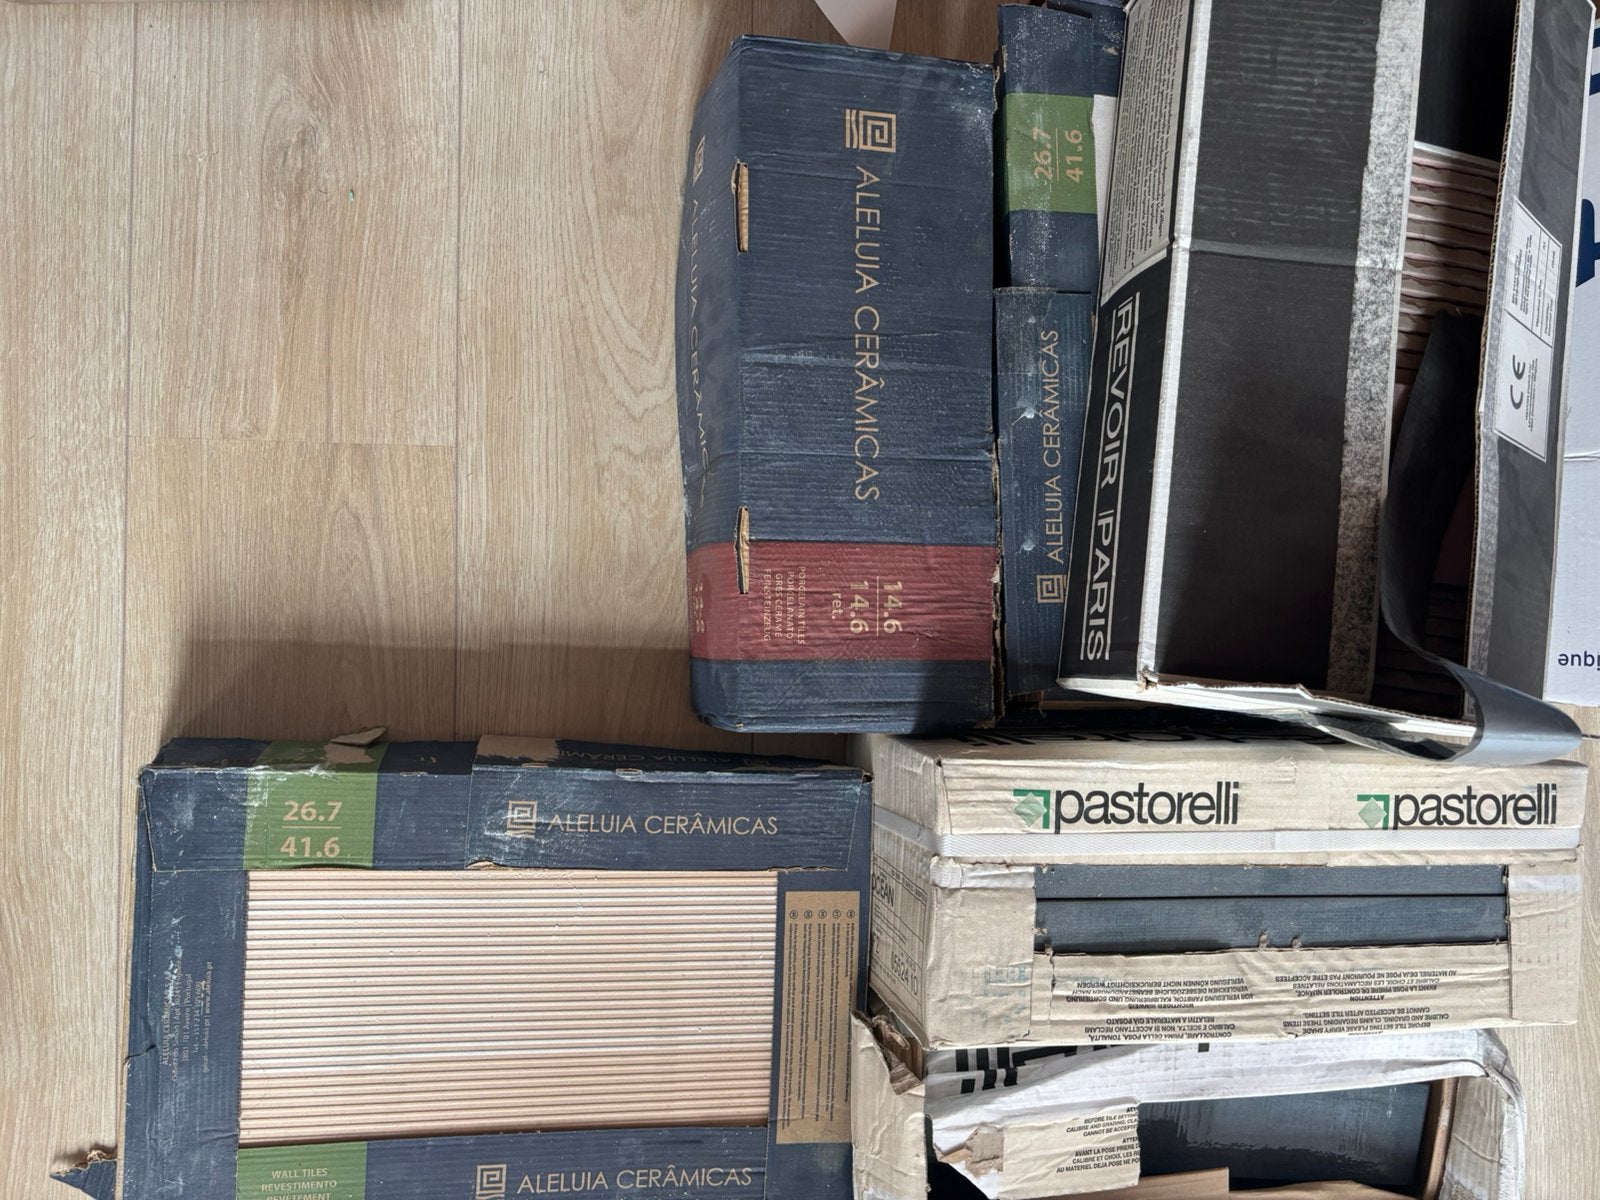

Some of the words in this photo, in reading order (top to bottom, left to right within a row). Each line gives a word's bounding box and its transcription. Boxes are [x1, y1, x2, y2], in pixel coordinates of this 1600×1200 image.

[1031, 127, 1052, 181] 26.7
[1065, 129, 1083, 183] 41.6
[854, 166, 881, 295] ALELUIA
[854, 305, 886, 503] CERÂMICAS
[1037, 330, 1061, 468] CERÂMICAS
[1101, 297, 1134, 489] REVOIR
[1044, 474, 1064, 564] ALELUIA
[797, 566, 806, 618] PORCELAIN
[1087, 508, 1116, 660] PARIS
[763, 568, 772, 642] FEINSTEINZEUG
[786, 571, 795, 639] PORCELANATO
[832, 592, 844, 620] ret.
[850, 580, 870, 634] 14.6
[883, 581, 903, 634] 14.6
[797, 619, 806, 645] TILES
[283, 799, 342, 822] 26.7
[1054, 781, 1239, 835] pastorelli
[1393, 783, 1557, 831] pastorelli
[547, 813, 638, 834] ALELUIA
[644, 812, 779, 836] CERÂMICAS
[280, 835, 341, 858] 41.6
[184, 973, 193, 1004] Portugal
[1208, 986, 1249, 994] VERGLEICHEN
[1210, 978, 1245, 986] VERLEGUNG
[1275, 975, 1311, 983] ACCEPTEES
[1392, 985, 1409, 993] POSE
[1204, 994, 1240, 1002] VERLEGUNG
[1323, 988, 1361, 996] CONTROLER
[1349, 994, 1385, 1002] ATTENTION
[1359, 1017, 1382, 1025] CLAIMS
[1364, 1008, 1396, 1016] ACCEPTED
[1405, 1006, 1431, 1014] CANNOT
[1115, 1025, 1153, 1033] ACCETTANO
[1208, 1023, 1236, 1031] CALIBRO
[1323, 1018, 1359, 1026] REGARDING
[1066, 1124, 1089, 1133] CALIBRE
[1084, 1115, 1105, 1124] BEFORE
[1083, 1128, 1105, 1137] CANNOT
[1075, 1149, 1093, 1157] AVANT
[1116, 1144, 1135, 1152] PRIERE
[271, 1170, 299, 1179] WALL
[302, 1167, 328, 1177] TILES
[517, 1172, 609, 1195] ALELUIA
[616, 1164, 753, 1190] CERÂMICAS
[1065, 1164, 1092, 1172] MATERIEL
[261, 1180, 337, 1192] REVESTIMENTO
